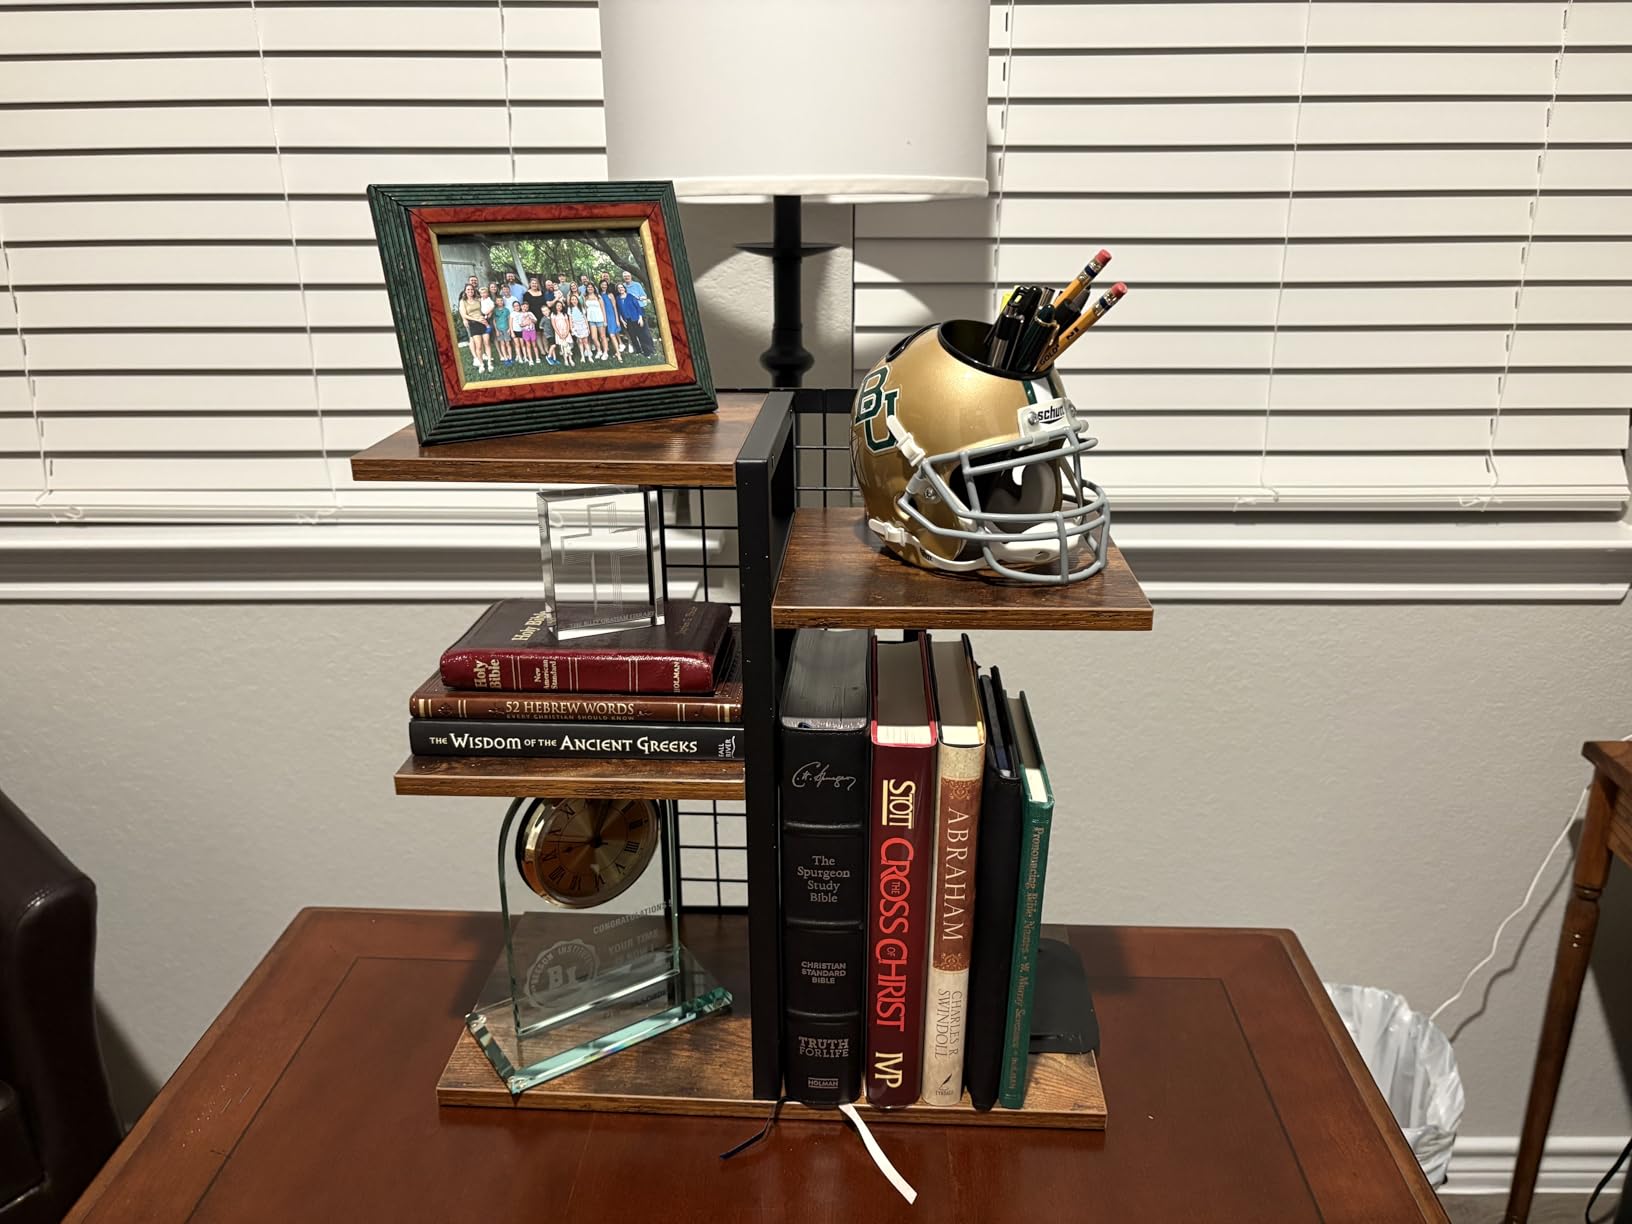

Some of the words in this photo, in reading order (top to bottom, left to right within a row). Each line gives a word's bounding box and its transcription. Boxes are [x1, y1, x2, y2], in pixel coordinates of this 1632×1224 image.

[511, 626, 541, 641] Holy
[473, 658, 489, 689] Holy
[488, 658, 502, 690] Bible
[550, 657, 558, 690] Standard
[673, 661, 681, 693] HOLMAN
[505, 701, 520, 713] 52
[523, 701, 580, 714] HEBREW
[583, 702, 634, 715] WORDS
[429, 736, 448, 746] THE
[449, 732, 522, 750] WISDOM
[524, 738, 537, 748] OF
[538, 738, 558, 748] THE
[559, 734, 633, 752] ANCIENT
[636, 735, 698, 755] GREEKS
[724, 738, 732, 758] RIVER
[888, 778, 916, 830] STOTT
[812, 855, 836, 866] The
[1025, 826, 1045, 890] Pronouncing
[797, 866, 851, 880] Spurgeon
[942, 807, 970, 941] ABRAHAM
[807, 881, 841, 894] Study
[878, 837, 915, 934] CROSS
[891, 881, 902, 894] THE
[810, 892, 838, 903] Bible
[1025, 892, 1039, 917] Bible
[801, 961, 847, 970] CHRISTIAN
[801, 968, 847, 977] STANDARD
[812, 976, 836, 984] BIBLE
[875, 938, 910, 1032] CHRIST
[935, 988, 950, 1060] SWINDOLL
[949, 990, 963, 1045] CHARLES
[798, 1036, 849, 1049] TRUTH
[874, 1051, 904, 1089] IVP
[808, 1079, 839, 1087] HOLMAN
